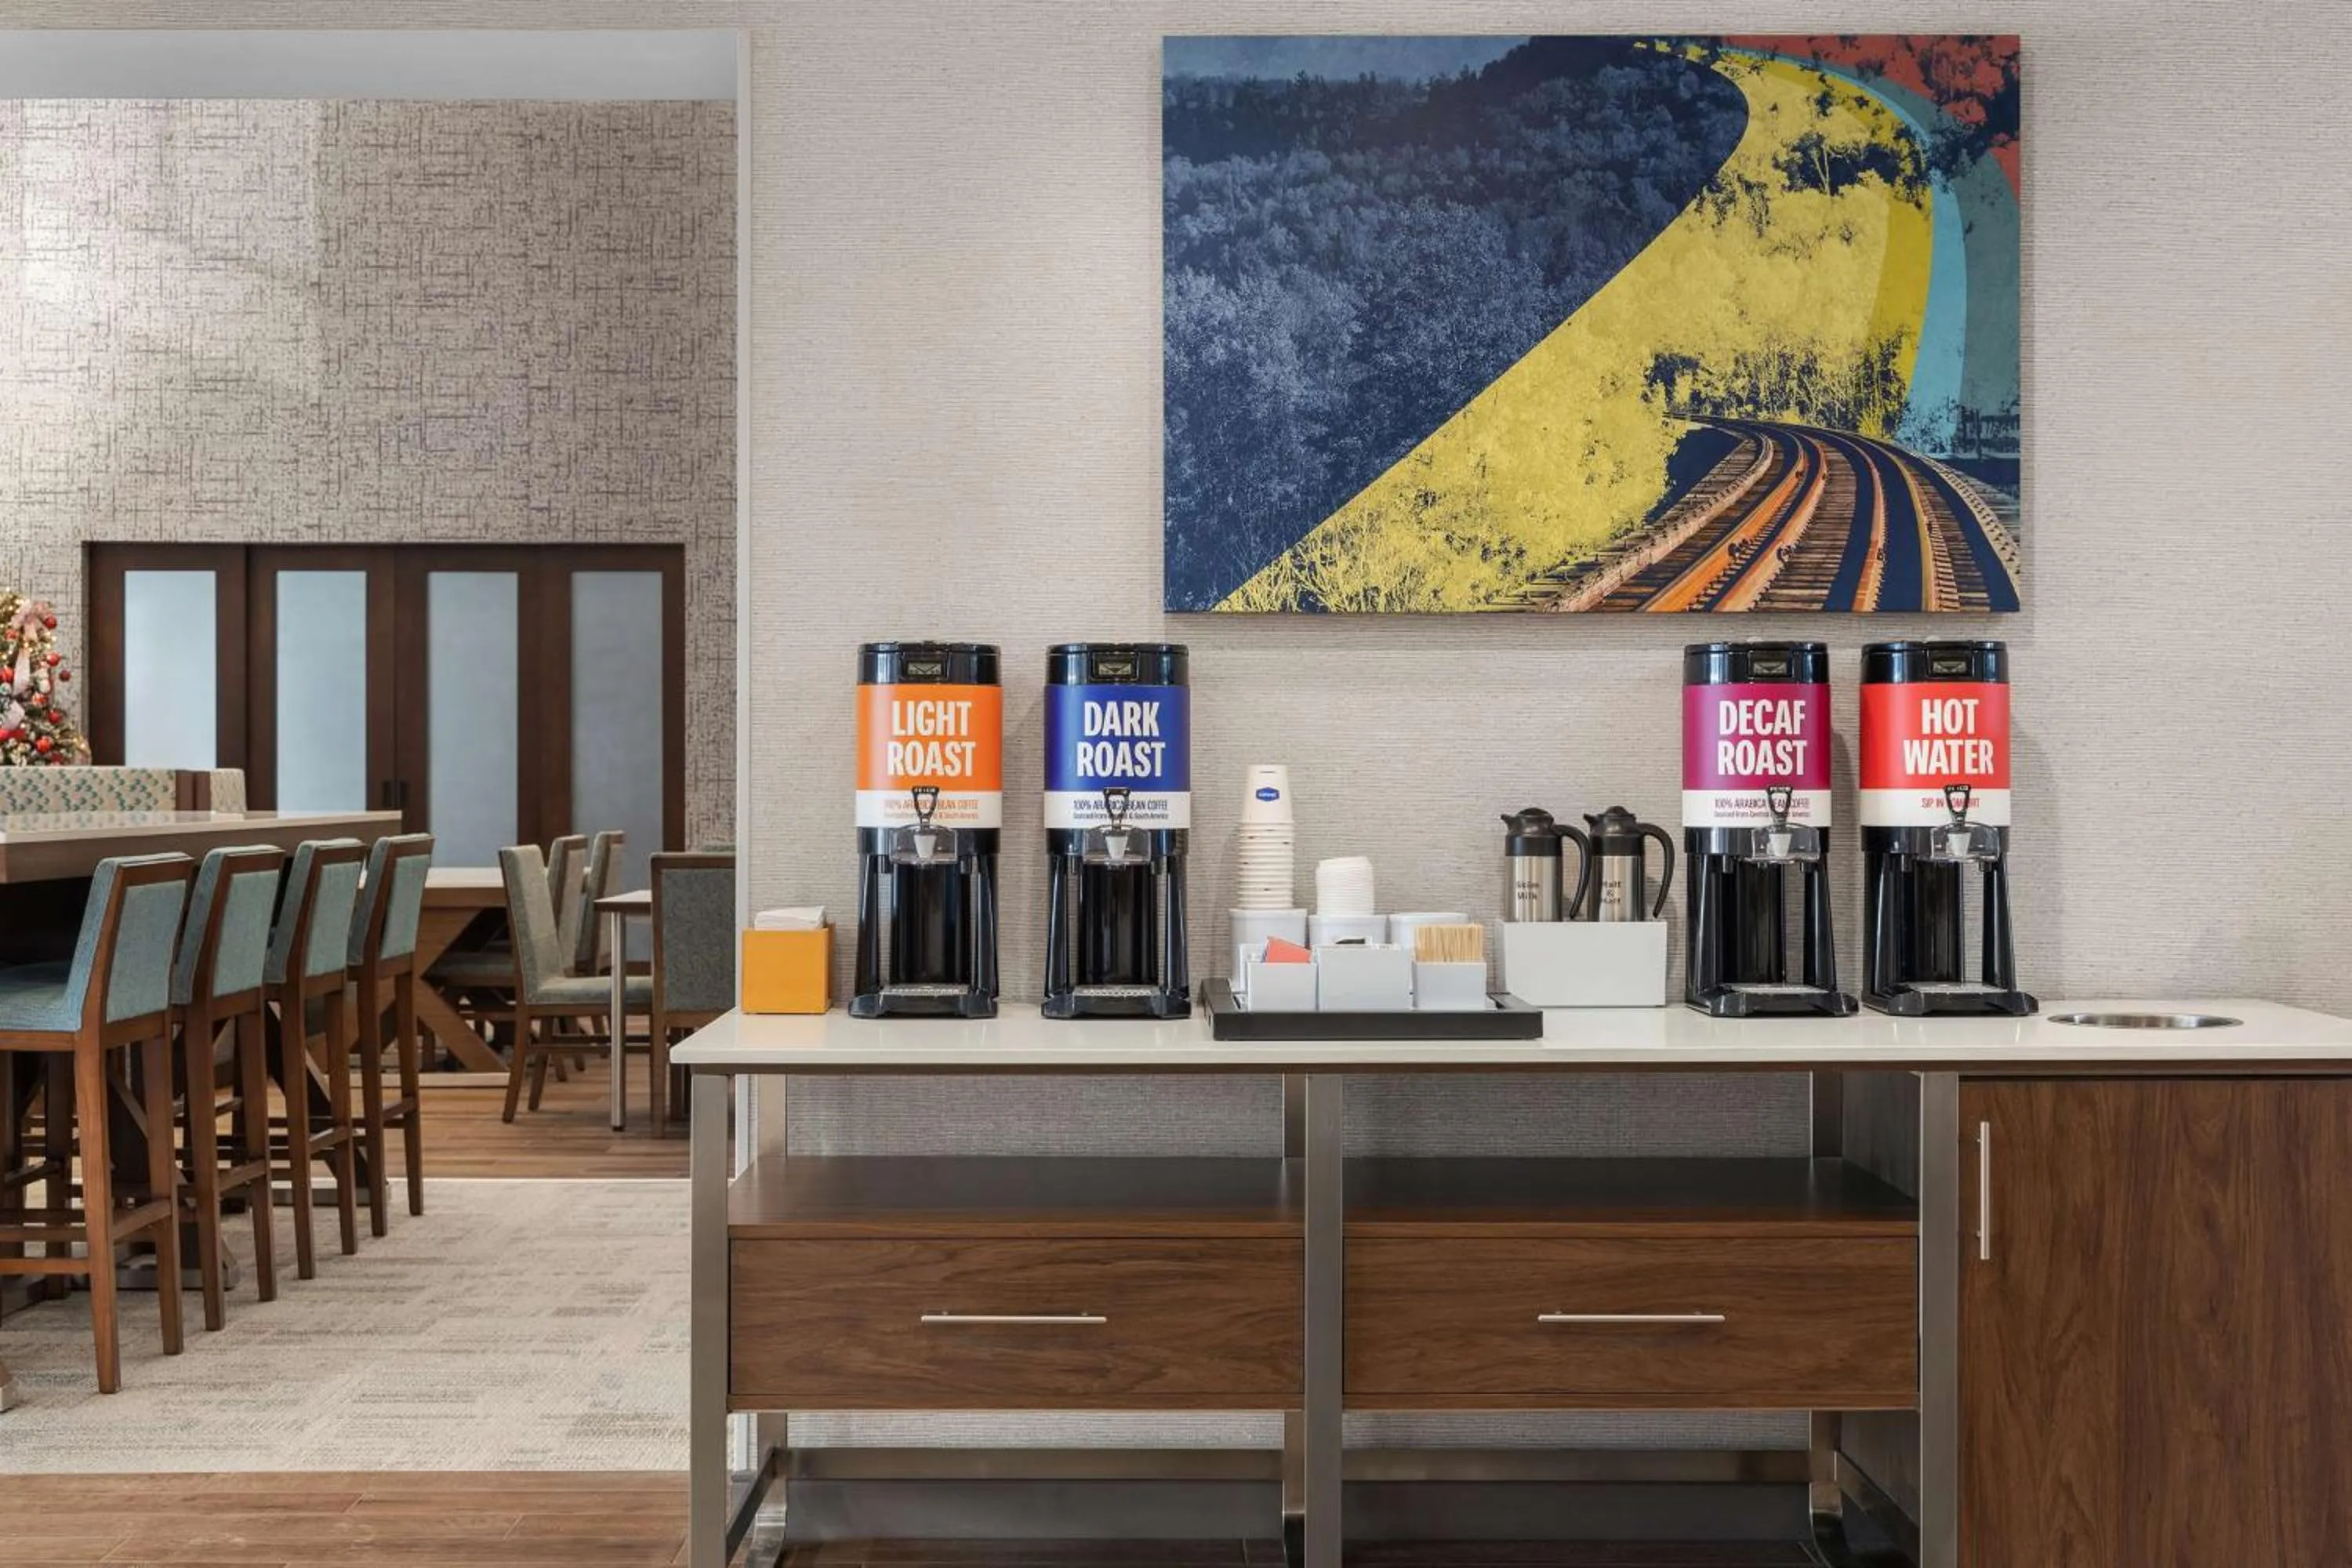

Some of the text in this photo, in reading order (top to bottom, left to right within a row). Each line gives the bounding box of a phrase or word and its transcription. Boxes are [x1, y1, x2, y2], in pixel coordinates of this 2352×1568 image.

[892, 700, 972, 736] LIGHT
[1083, 701, 1160, 736] DARK
[1719, 699, 1806, 735] DECAF
[1922, 699, 1980, 735] HOT
[887, 740, 976, 777] ROAST
[1076, 741, 1166, 777] ROAST
[1718, 739, 1808, 775] ROAST
[1903, 739, 1994, 775] WATER
[957, 799, 978, 809] COFFEE
[1073, 799, 1091, 810] 100%
[1147, 799, 1167, 810] COFFEE
[1715, 798, 1733, 808] 100%
[1734, 798, 1766, 808] ARABICA
[1922, 797, 1934, 808] SIP
[1936, 797, 1944, 808] IN
